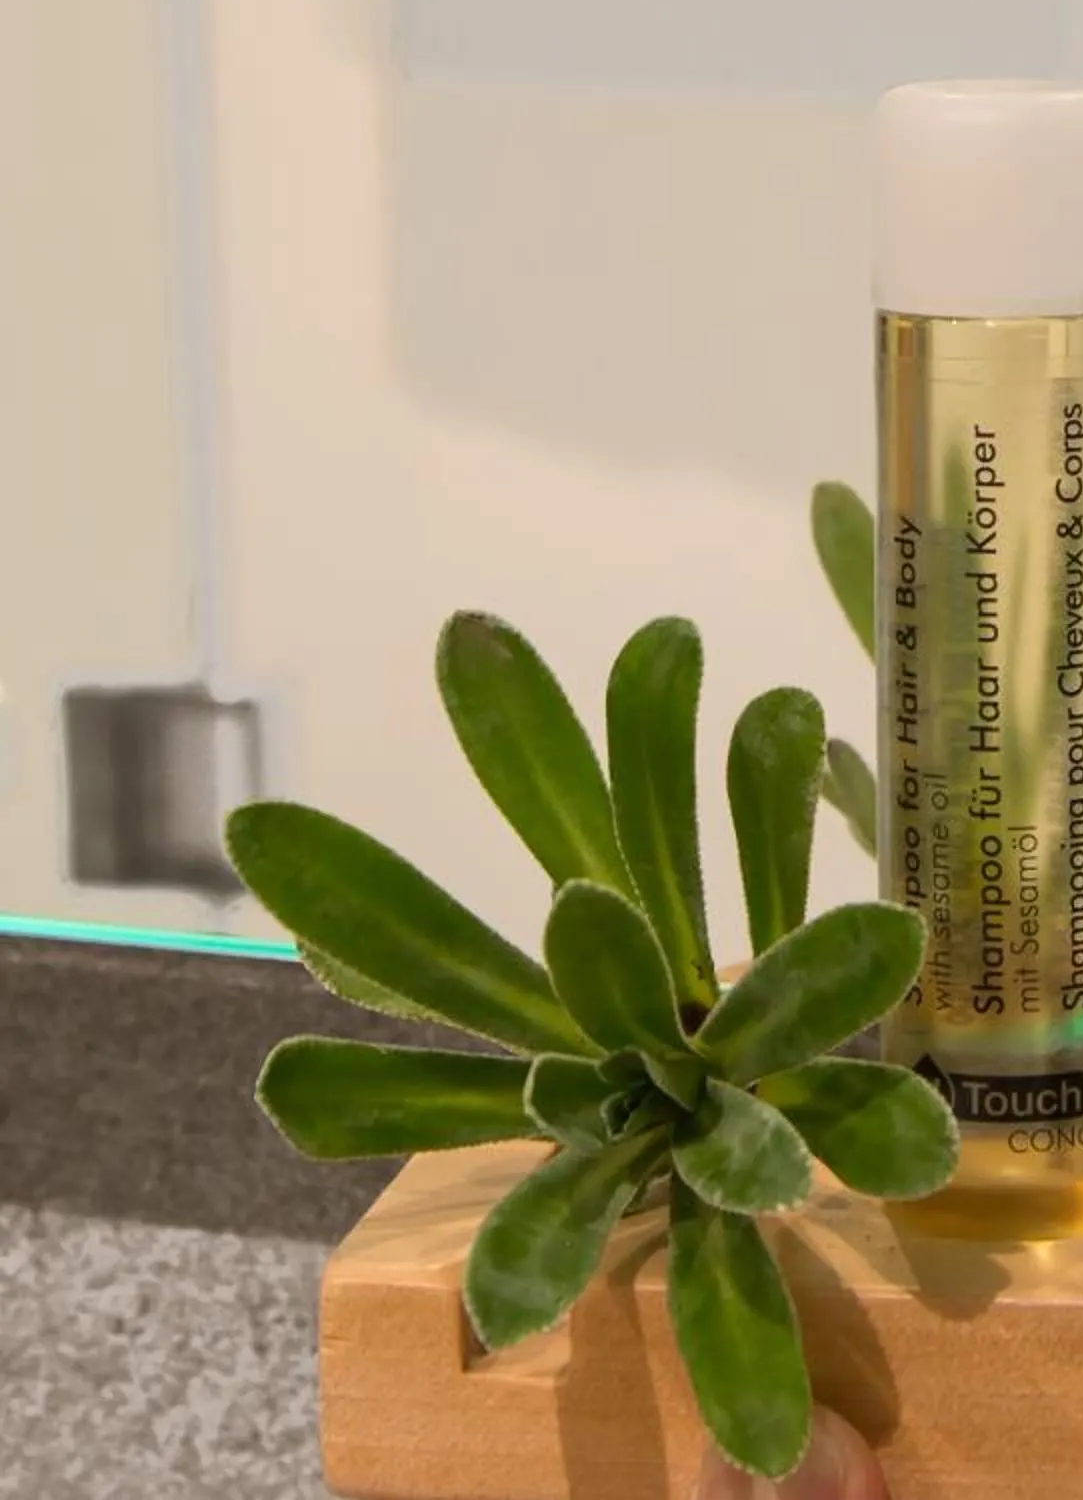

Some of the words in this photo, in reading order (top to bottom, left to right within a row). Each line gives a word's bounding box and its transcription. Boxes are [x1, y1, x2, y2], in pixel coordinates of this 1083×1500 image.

[966, 425, 1004, 555] Körper
[894, 516, 922, 608] Body
[1056, 515, 1083, 539] &
[896, 625, 916, 651] &
[965, 572, 998, 643] und
[896, 664, 918, 745] Hair
[970, 657, 1000, 753] Haar
[897, 760, 919, 812] for
[924, 773, 948, 811] oil
[968, 768, 1001, 820] für
[903, 826, 926, 1007] Spoo
[932, 823, 951, 939] sesame
[1008, 826, 1039, 955] Sesamöl
[973, 835, 1010, 1015] Shampoo
[927, 952, 952, 1011] with
[1013, 968, 1040, 1012] mit
[962, 1079, 1082, 1117] Touch
